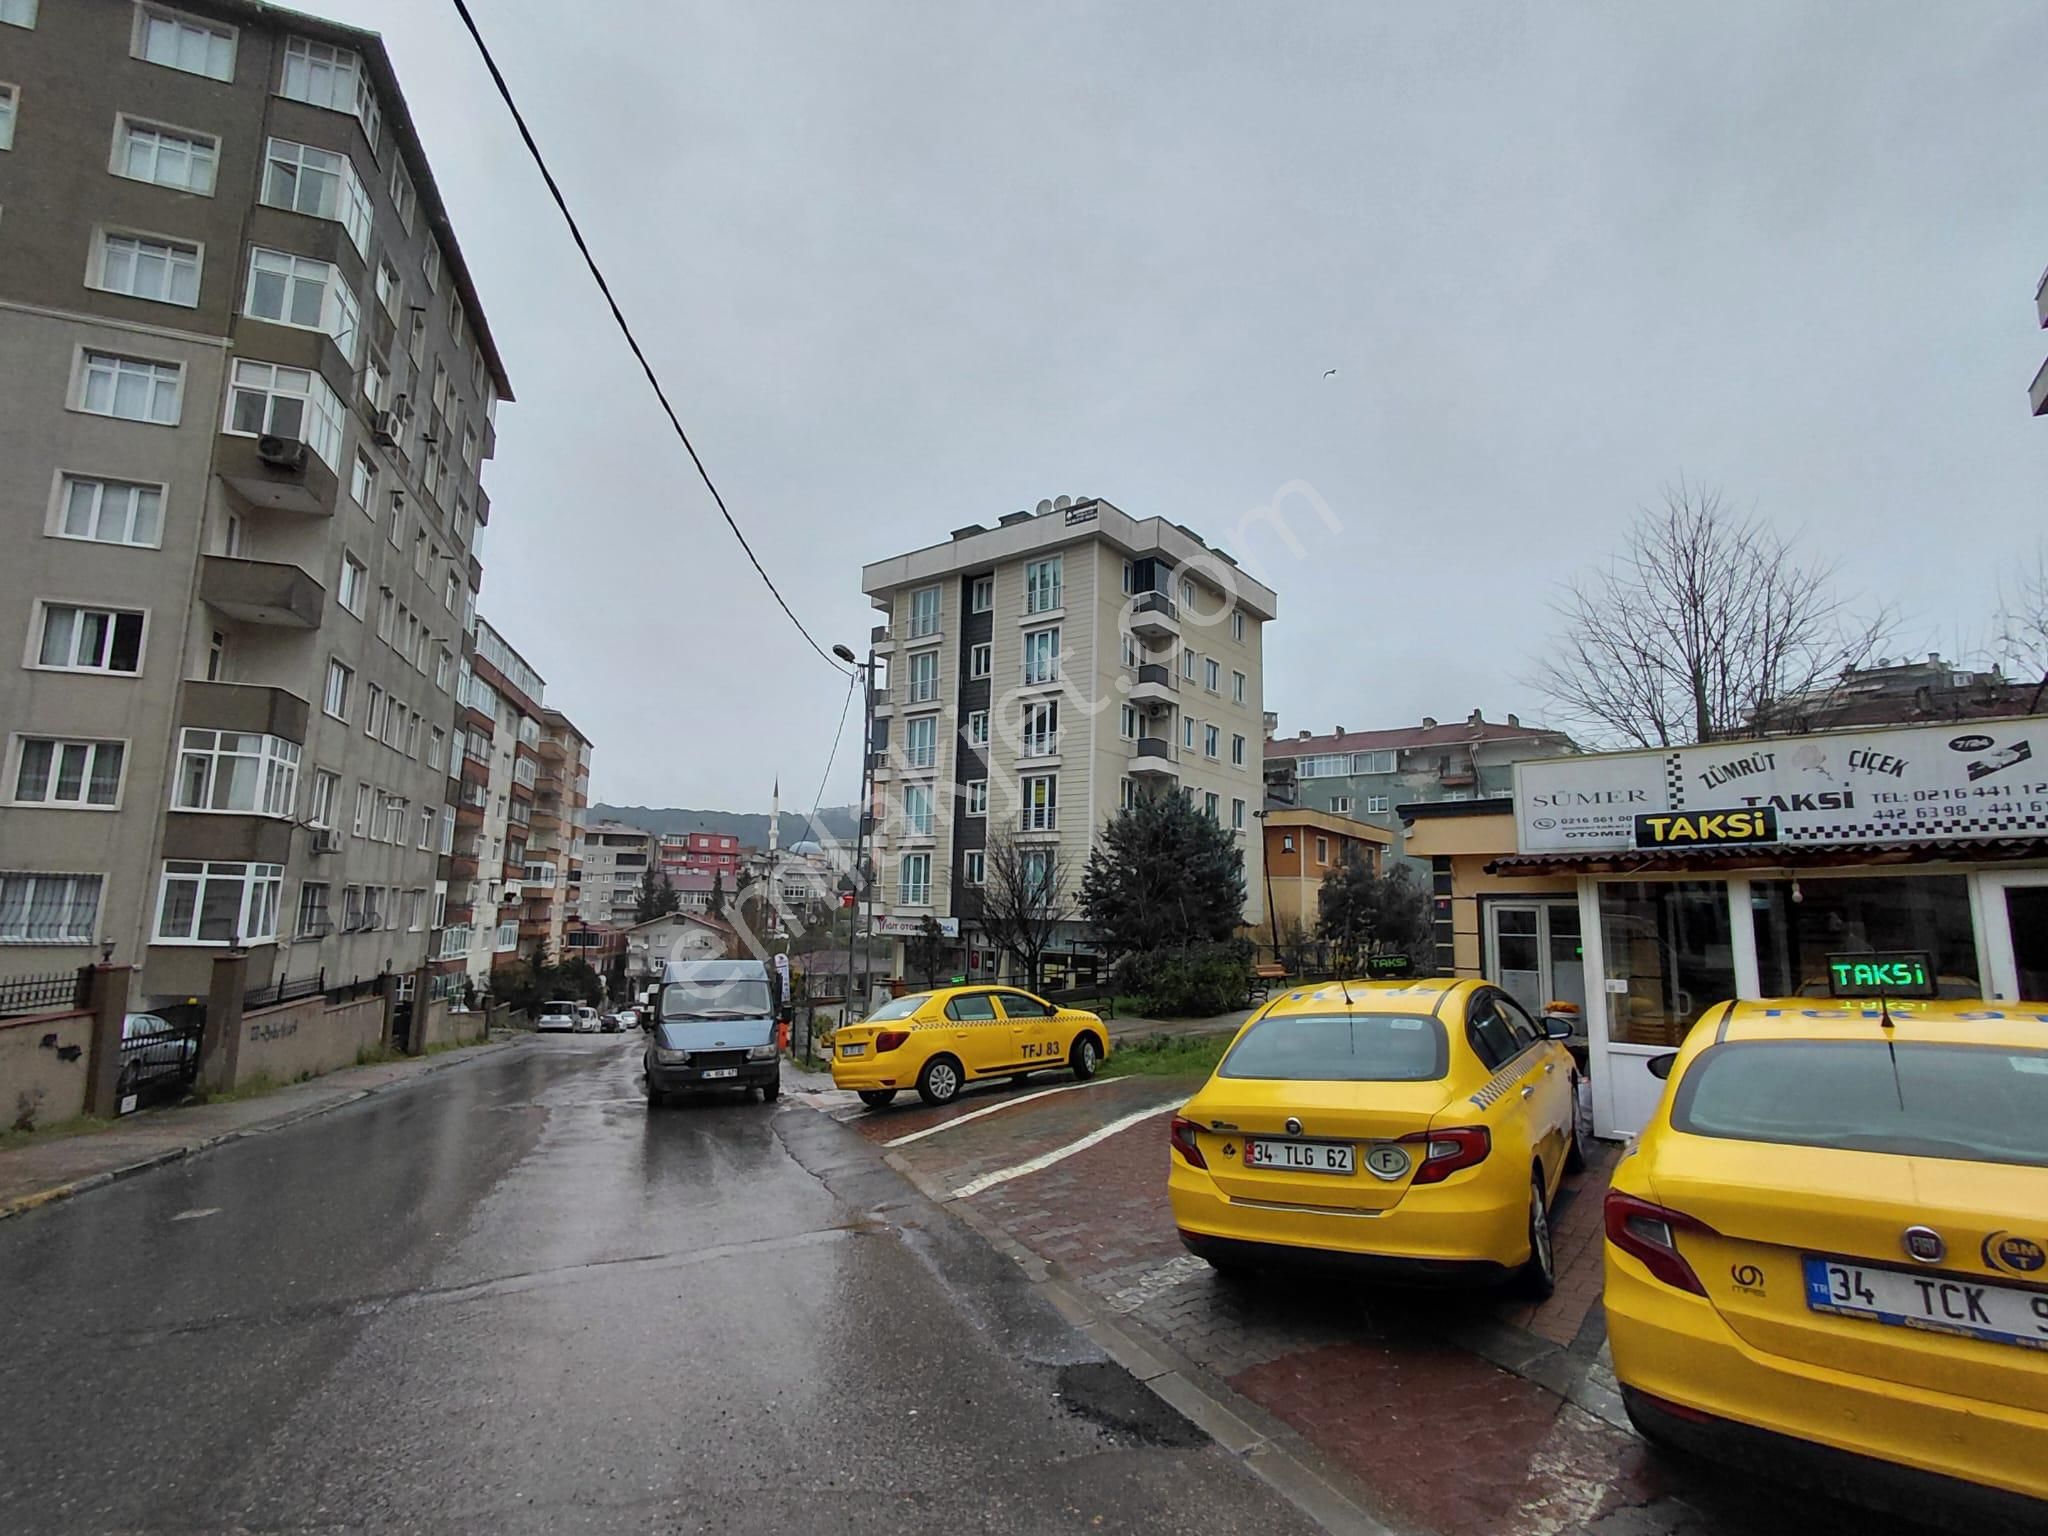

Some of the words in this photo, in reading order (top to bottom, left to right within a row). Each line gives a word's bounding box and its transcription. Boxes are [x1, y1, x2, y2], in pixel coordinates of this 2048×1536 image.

[1698, 752, 1776, 790] ZÜMRÜT
[1848, 746, 1910, 778] ÇİÇEK
[1532, 789, 1649, 808] SÜMER
[1914, 788, 1967, 801] 0216
[1973, 785, 2011, 798] 441
[1873, 808, 1906, 820] 442
[2030, 801, 2048, 812] 6
[1021, 1042, 1043, 1058] TFJ
[1046, 1040, 1060, 1056] 83
[1254, 1143, 1273, 1163] 34
[1284, 1146, 1314, 1166] TLG
[1326, 1149, 1348, 1168] 62
[1829, 1267, 1875, 1306] 34
[1914, 1279, 1992, 1326] TCK
